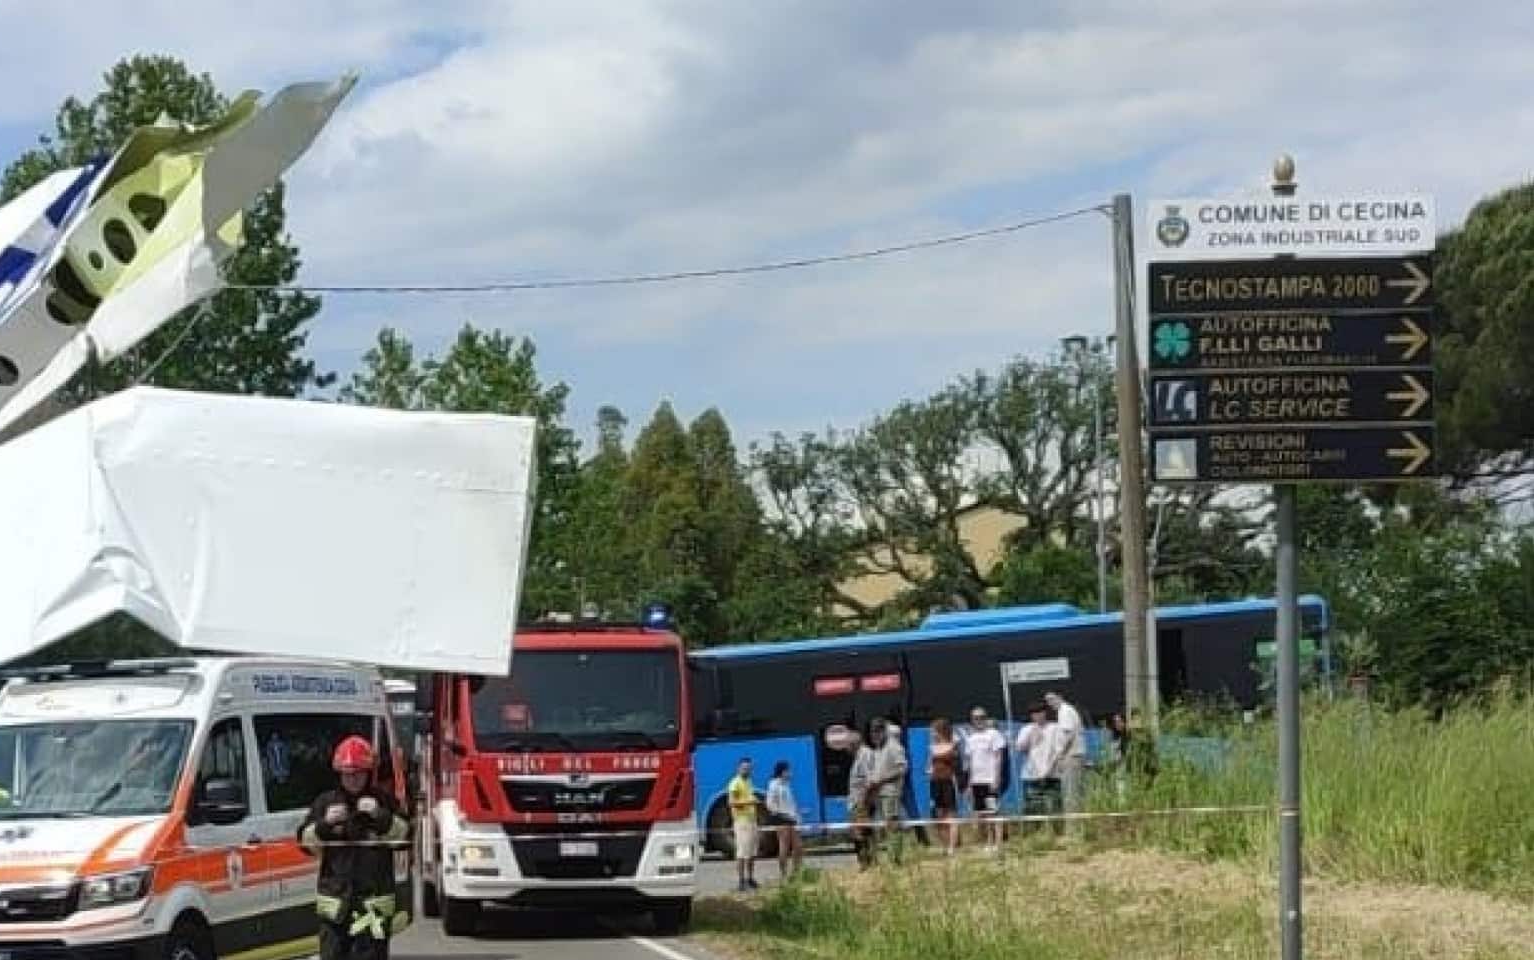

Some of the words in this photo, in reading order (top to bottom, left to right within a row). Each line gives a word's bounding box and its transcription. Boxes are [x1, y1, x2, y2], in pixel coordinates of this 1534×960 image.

[1198, 204, 1301, 224] COMUNE
[1308, 204, 1331, 222] DI
[1337, 201, 1426, 221] CECINA
[1207, 231, 1257, 247] ZONA
[1260, 228, 1375, 246] INDUSTRIALE
[1384, 227, 1421, 243] SUD
[1160, 274, 1326, 301] TECNOSTAMPA
[1330, 274, 1380, 299] 2000
[1201, 317, 1333, 332] AUTOFFICINA
[1258, 335, 1323, 352] GALLI
[1209, 376, 1350, 395] AUTOFFICINA
[1210, 400, 1241, 418] LC
[1248, 399, 1351, 418] SERVICE
[1209, 433, 1306, 450] REVISIONI
